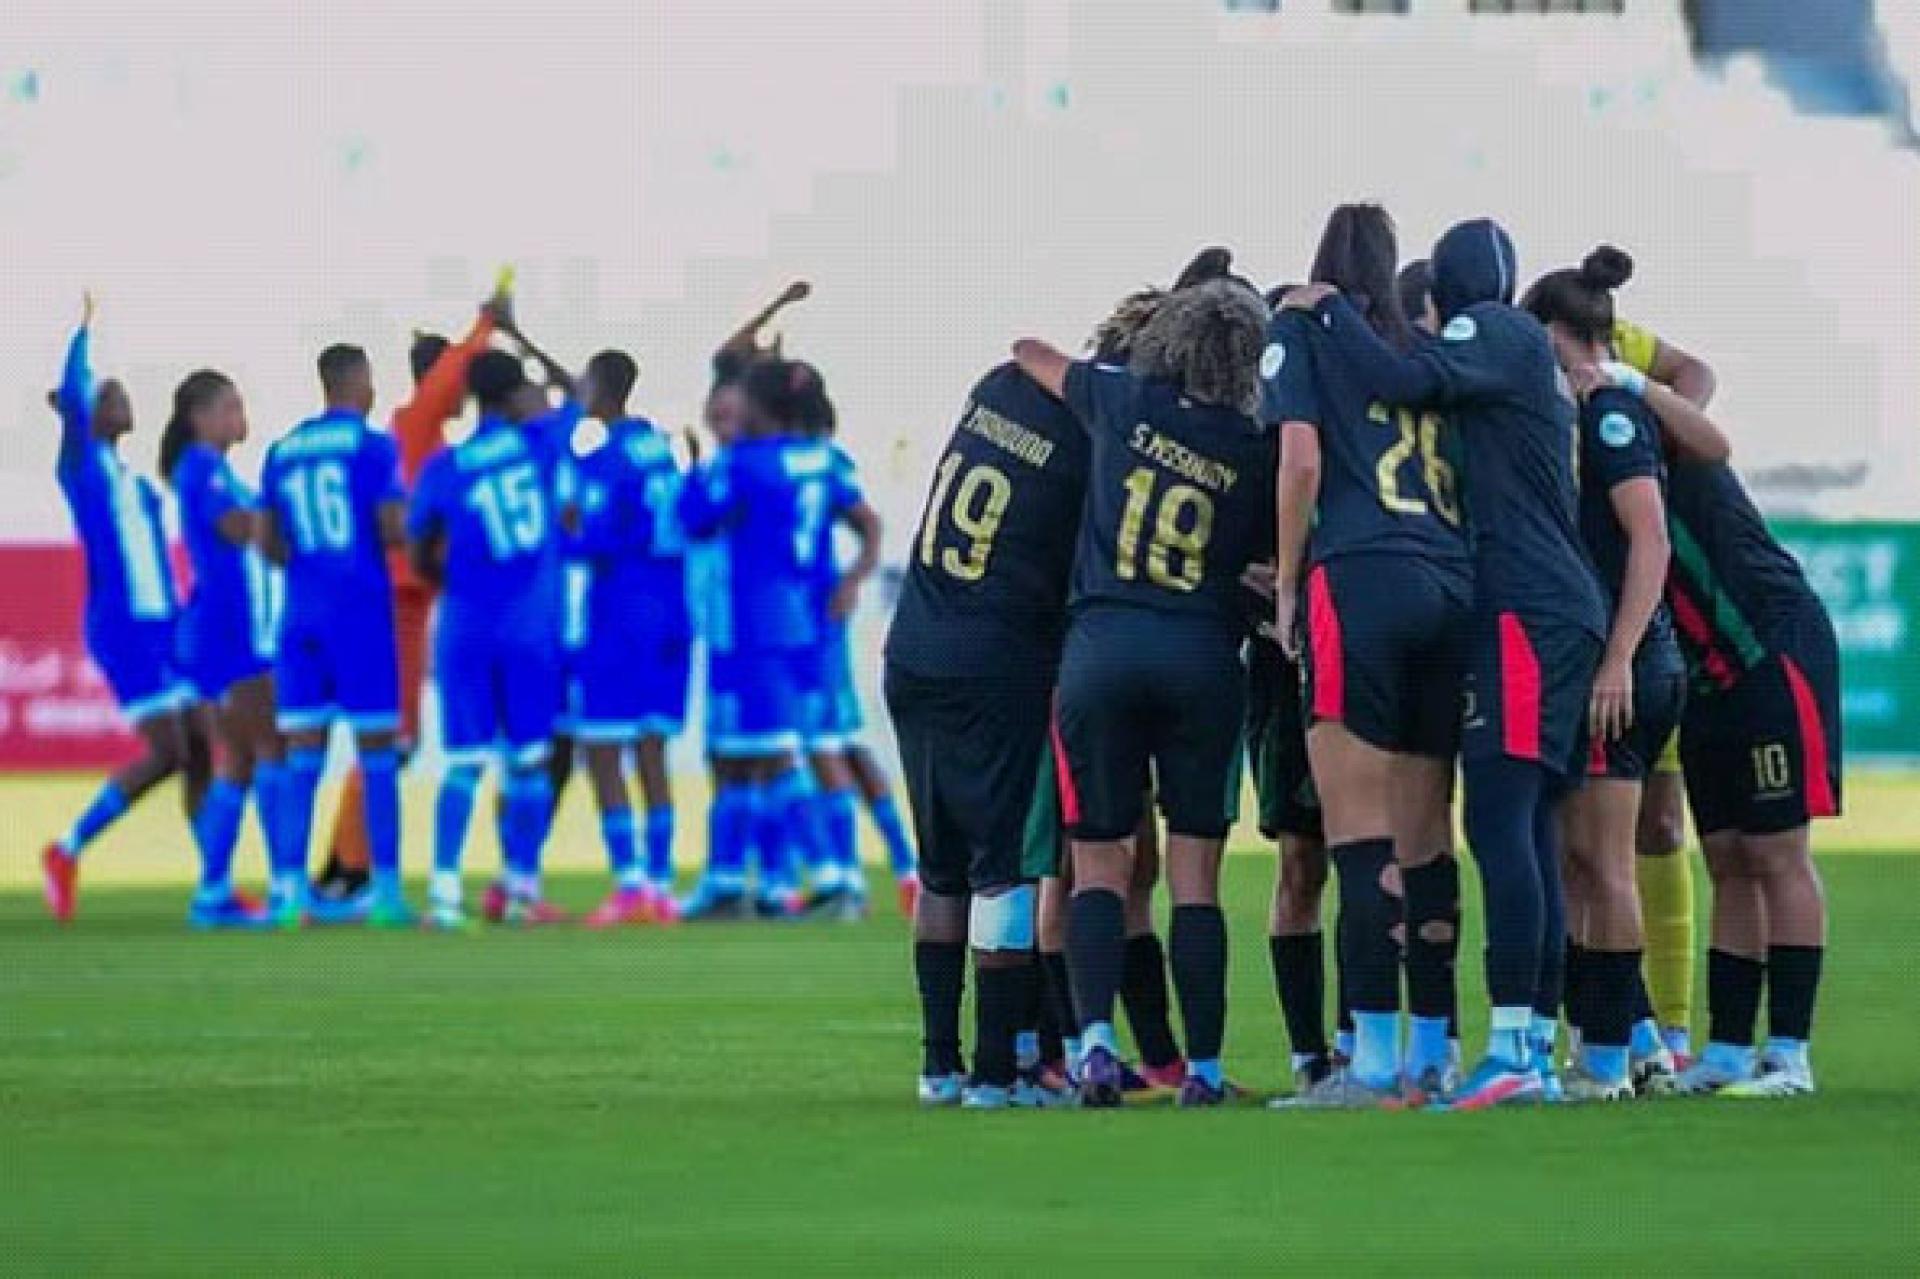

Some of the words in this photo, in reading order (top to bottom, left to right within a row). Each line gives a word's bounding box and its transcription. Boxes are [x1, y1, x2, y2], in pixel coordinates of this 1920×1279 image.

[281, 460, 351, 550] 16
[469, 462, 544, 557] 15
[921, 452, 1011, 581] 19
[1116, 465, 1213, 592] 18
